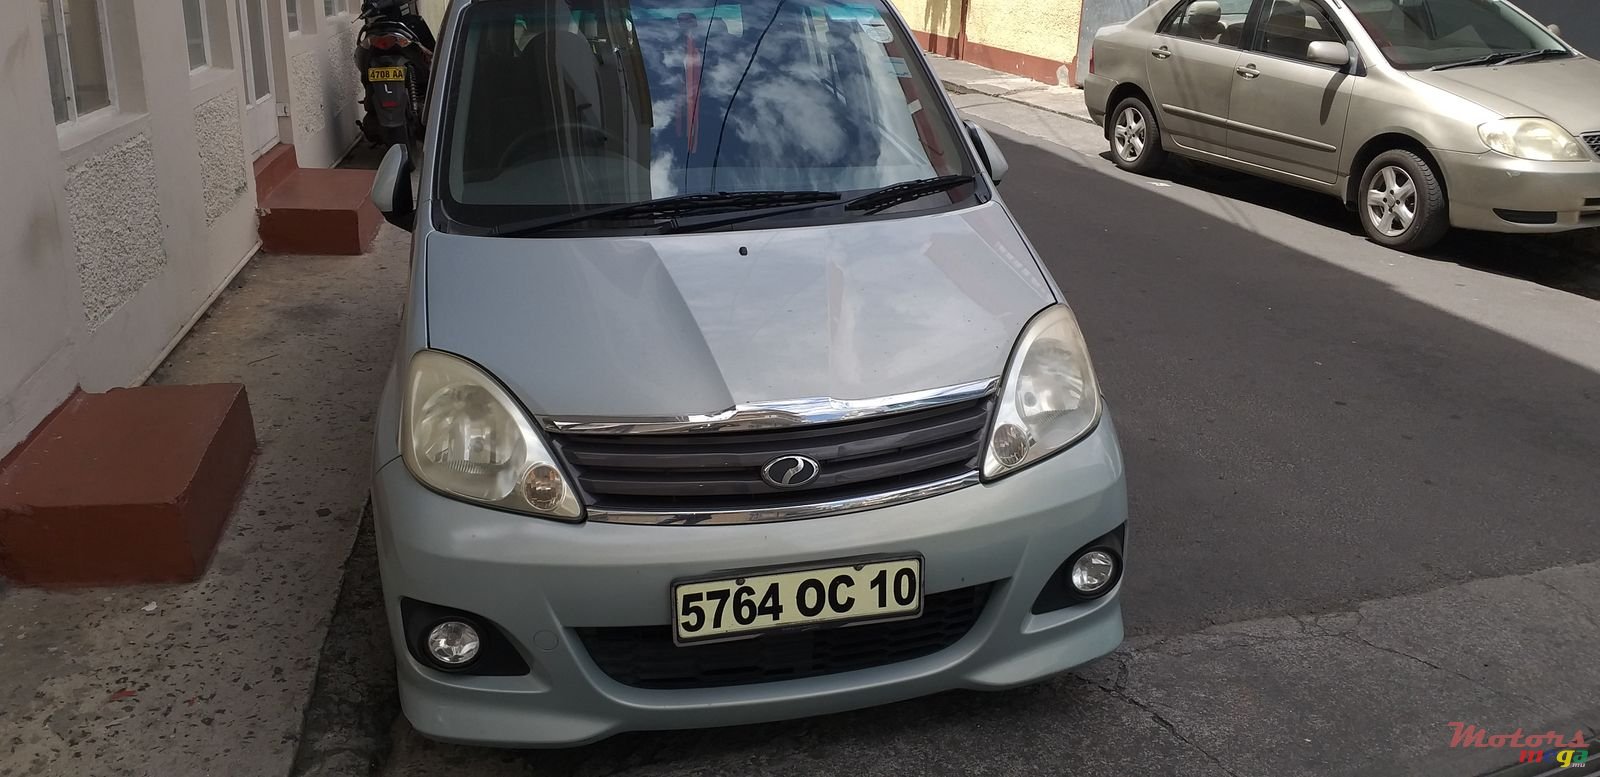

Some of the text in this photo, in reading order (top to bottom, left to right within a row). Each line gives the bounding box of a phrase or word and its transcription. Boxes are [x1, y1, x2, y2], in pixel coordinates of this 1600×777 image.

[370, 70, 403, 78] 4708 AA
[681, 568, 916, 632] 5764 OC 10
